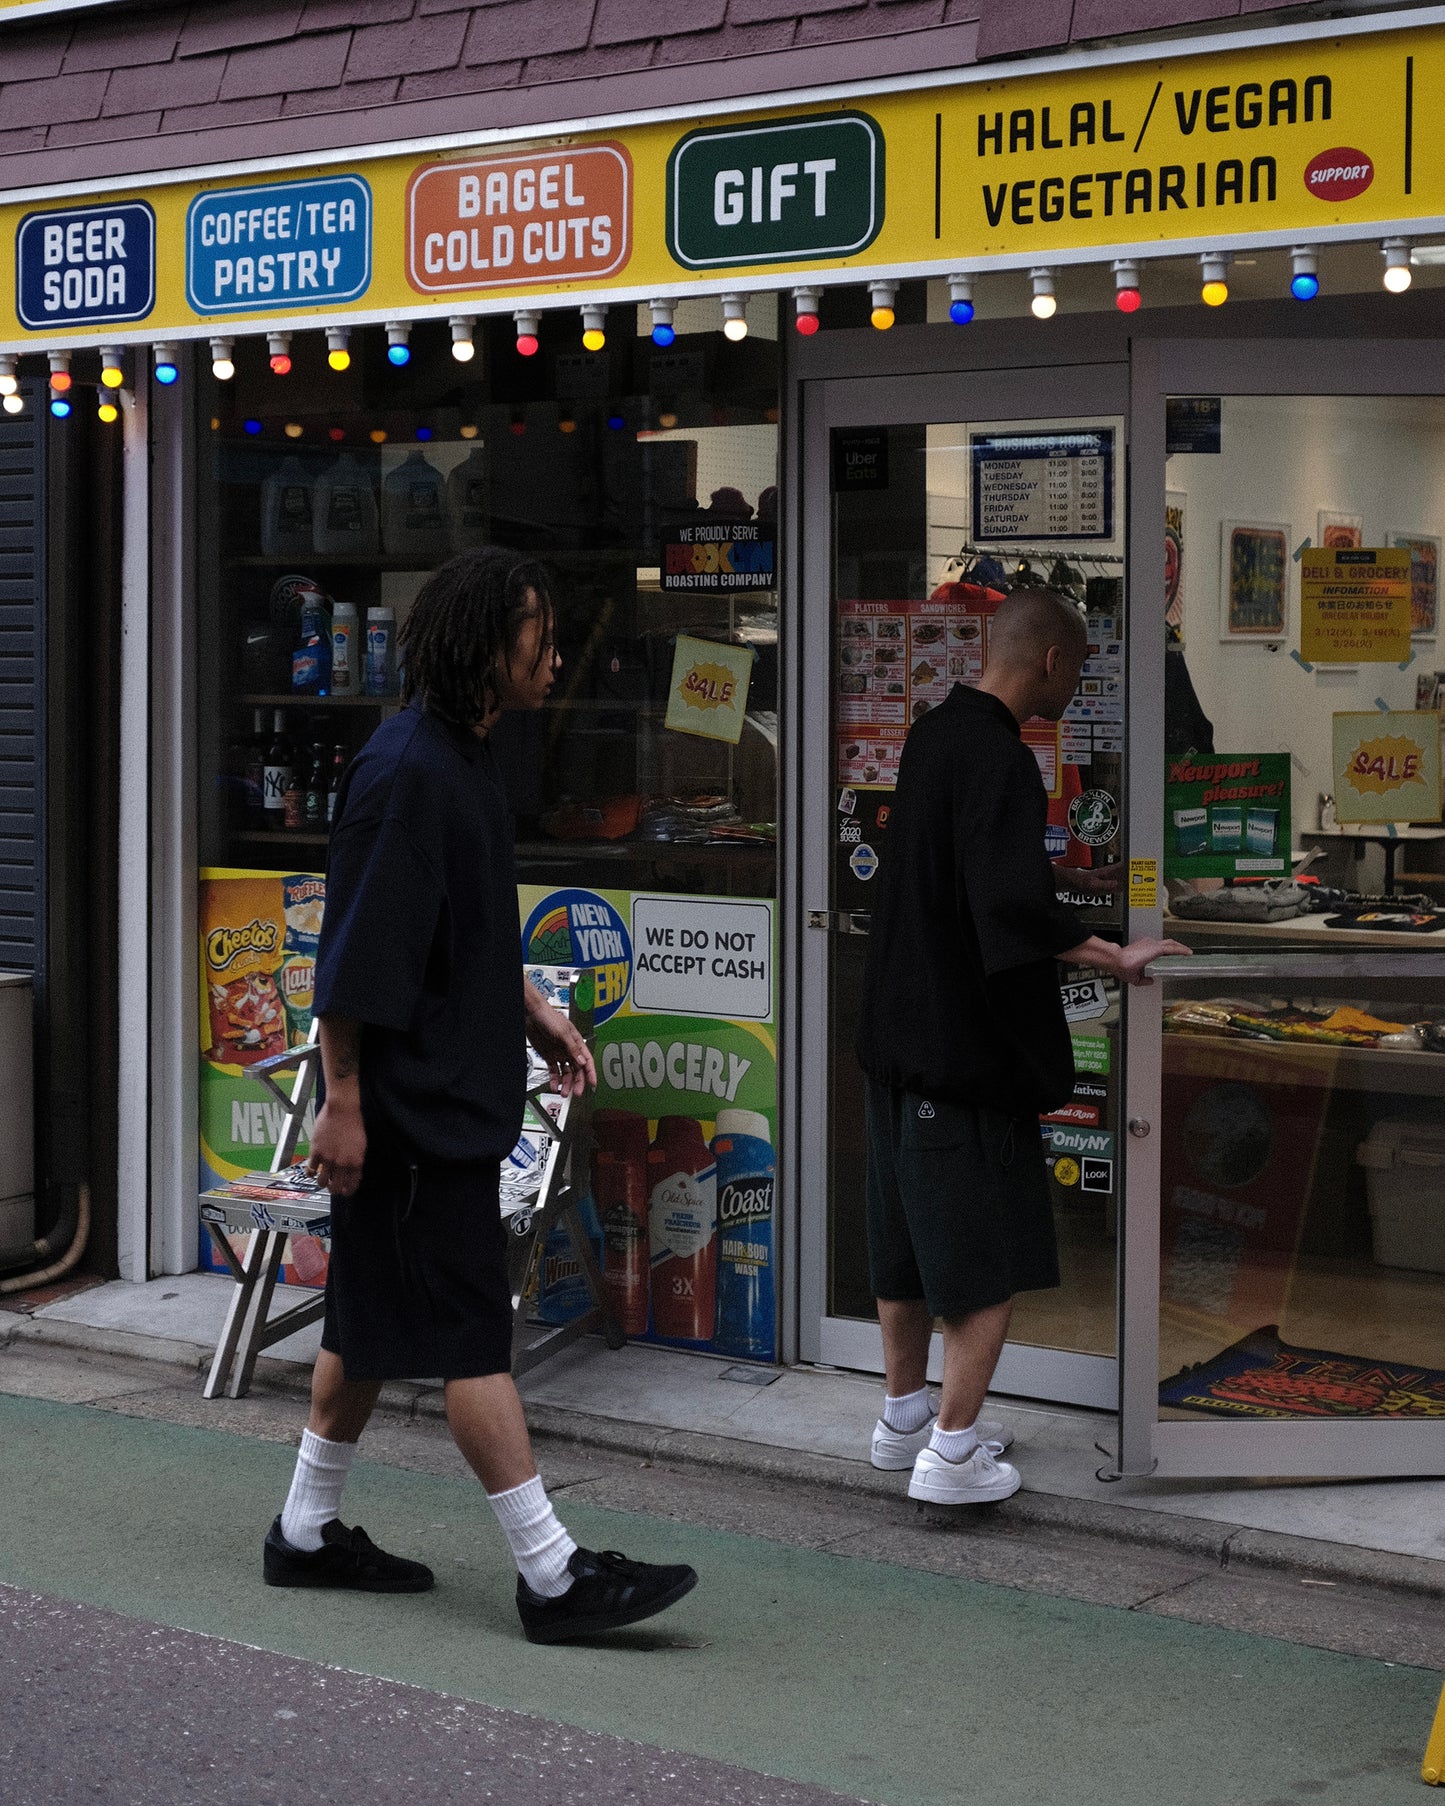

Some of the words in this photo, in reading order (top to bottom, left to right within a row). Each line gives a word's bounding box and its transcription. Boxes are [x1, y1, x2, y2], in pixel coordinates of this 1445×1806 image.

[1309, 164, 1370, 186] SUPPORT
[458, 163, 586, 218] BAGEL
[713, 158, 837, 226] GIFT
[982, 156, 1277, 228] VEGETARIAN
[44, 218, 126, 265] BEER
[424, 222, 513, 274] COLD
[523, 214, 611, 265] CUTS
[214, 247, 341, 297] PASTRY
[44, 264, 126, 311] SODA
[845, 451, 878, 465] Uber
[984, 462, 1021, 470] MONDAY
[846, 465, 878, 480] Eats
[984, 472, 1023, 480] TUESDAY
[984, 482, 1038, 491] WEDNESDAY
[984, 493, 1030, 501] THURSDAY
[984, 504, 1014, 512] FRIDAY
[984, 515, 1029, 523] SATURDAY
[680, 528, 693, 542] WE
[695, 525, 730, 541] PROUDLY
[732, 525, 759, 540] SERVE
[665, 574, 718, 588] ROASTING
[720, 573, 773, 587] COMPANY
[1334, 567, 1344, 579] &
[1349, 566, 1409, 579] GROCERY
[855, 603, 889, 613] PLATTERS
[920, 603, 967, 613] SANDWICHES
[686, 671, 733, 702] SALE
[1168, 757, 1261, 785] Newport
[1353, 751, 1418, 781] SALE
[1202, 779, 1285, 806] pleasure!
[1180, 814, 1206, 823] Newport
[1213, 823, 1241, 832] Newport
[1247, 822, 1273, 834] Newport
[840, 827, 862, 837] 2020
[1077, 824, 1116, 844] BREWERY
[570, 902, 612, 928] NEW
[208, 920, 276, 966] Cheetos
[575, 929, 625, 962] YORK
[646, 927, 674, 947] WE
[680, 929, 709, 949] DO
[715, 931, 756, 952] NOT
[636, 953, 706, 976] ACCEPT
[711, 957, 765, 980] CASH
[601, 1040, 752, 1102] GROCERY
[1073, 1084, 1107, 1097] latives
[1085, 1170, 1108, 1179] LOOK
[720, 1183, 772, 1221] Coast
[722, 1239, 743, 1255] HAIR
[747, 1242, 769, 1260] BODY
[735, 1263, 759, 1276] WASH
[671, 1277, 695, 1296] 3X
